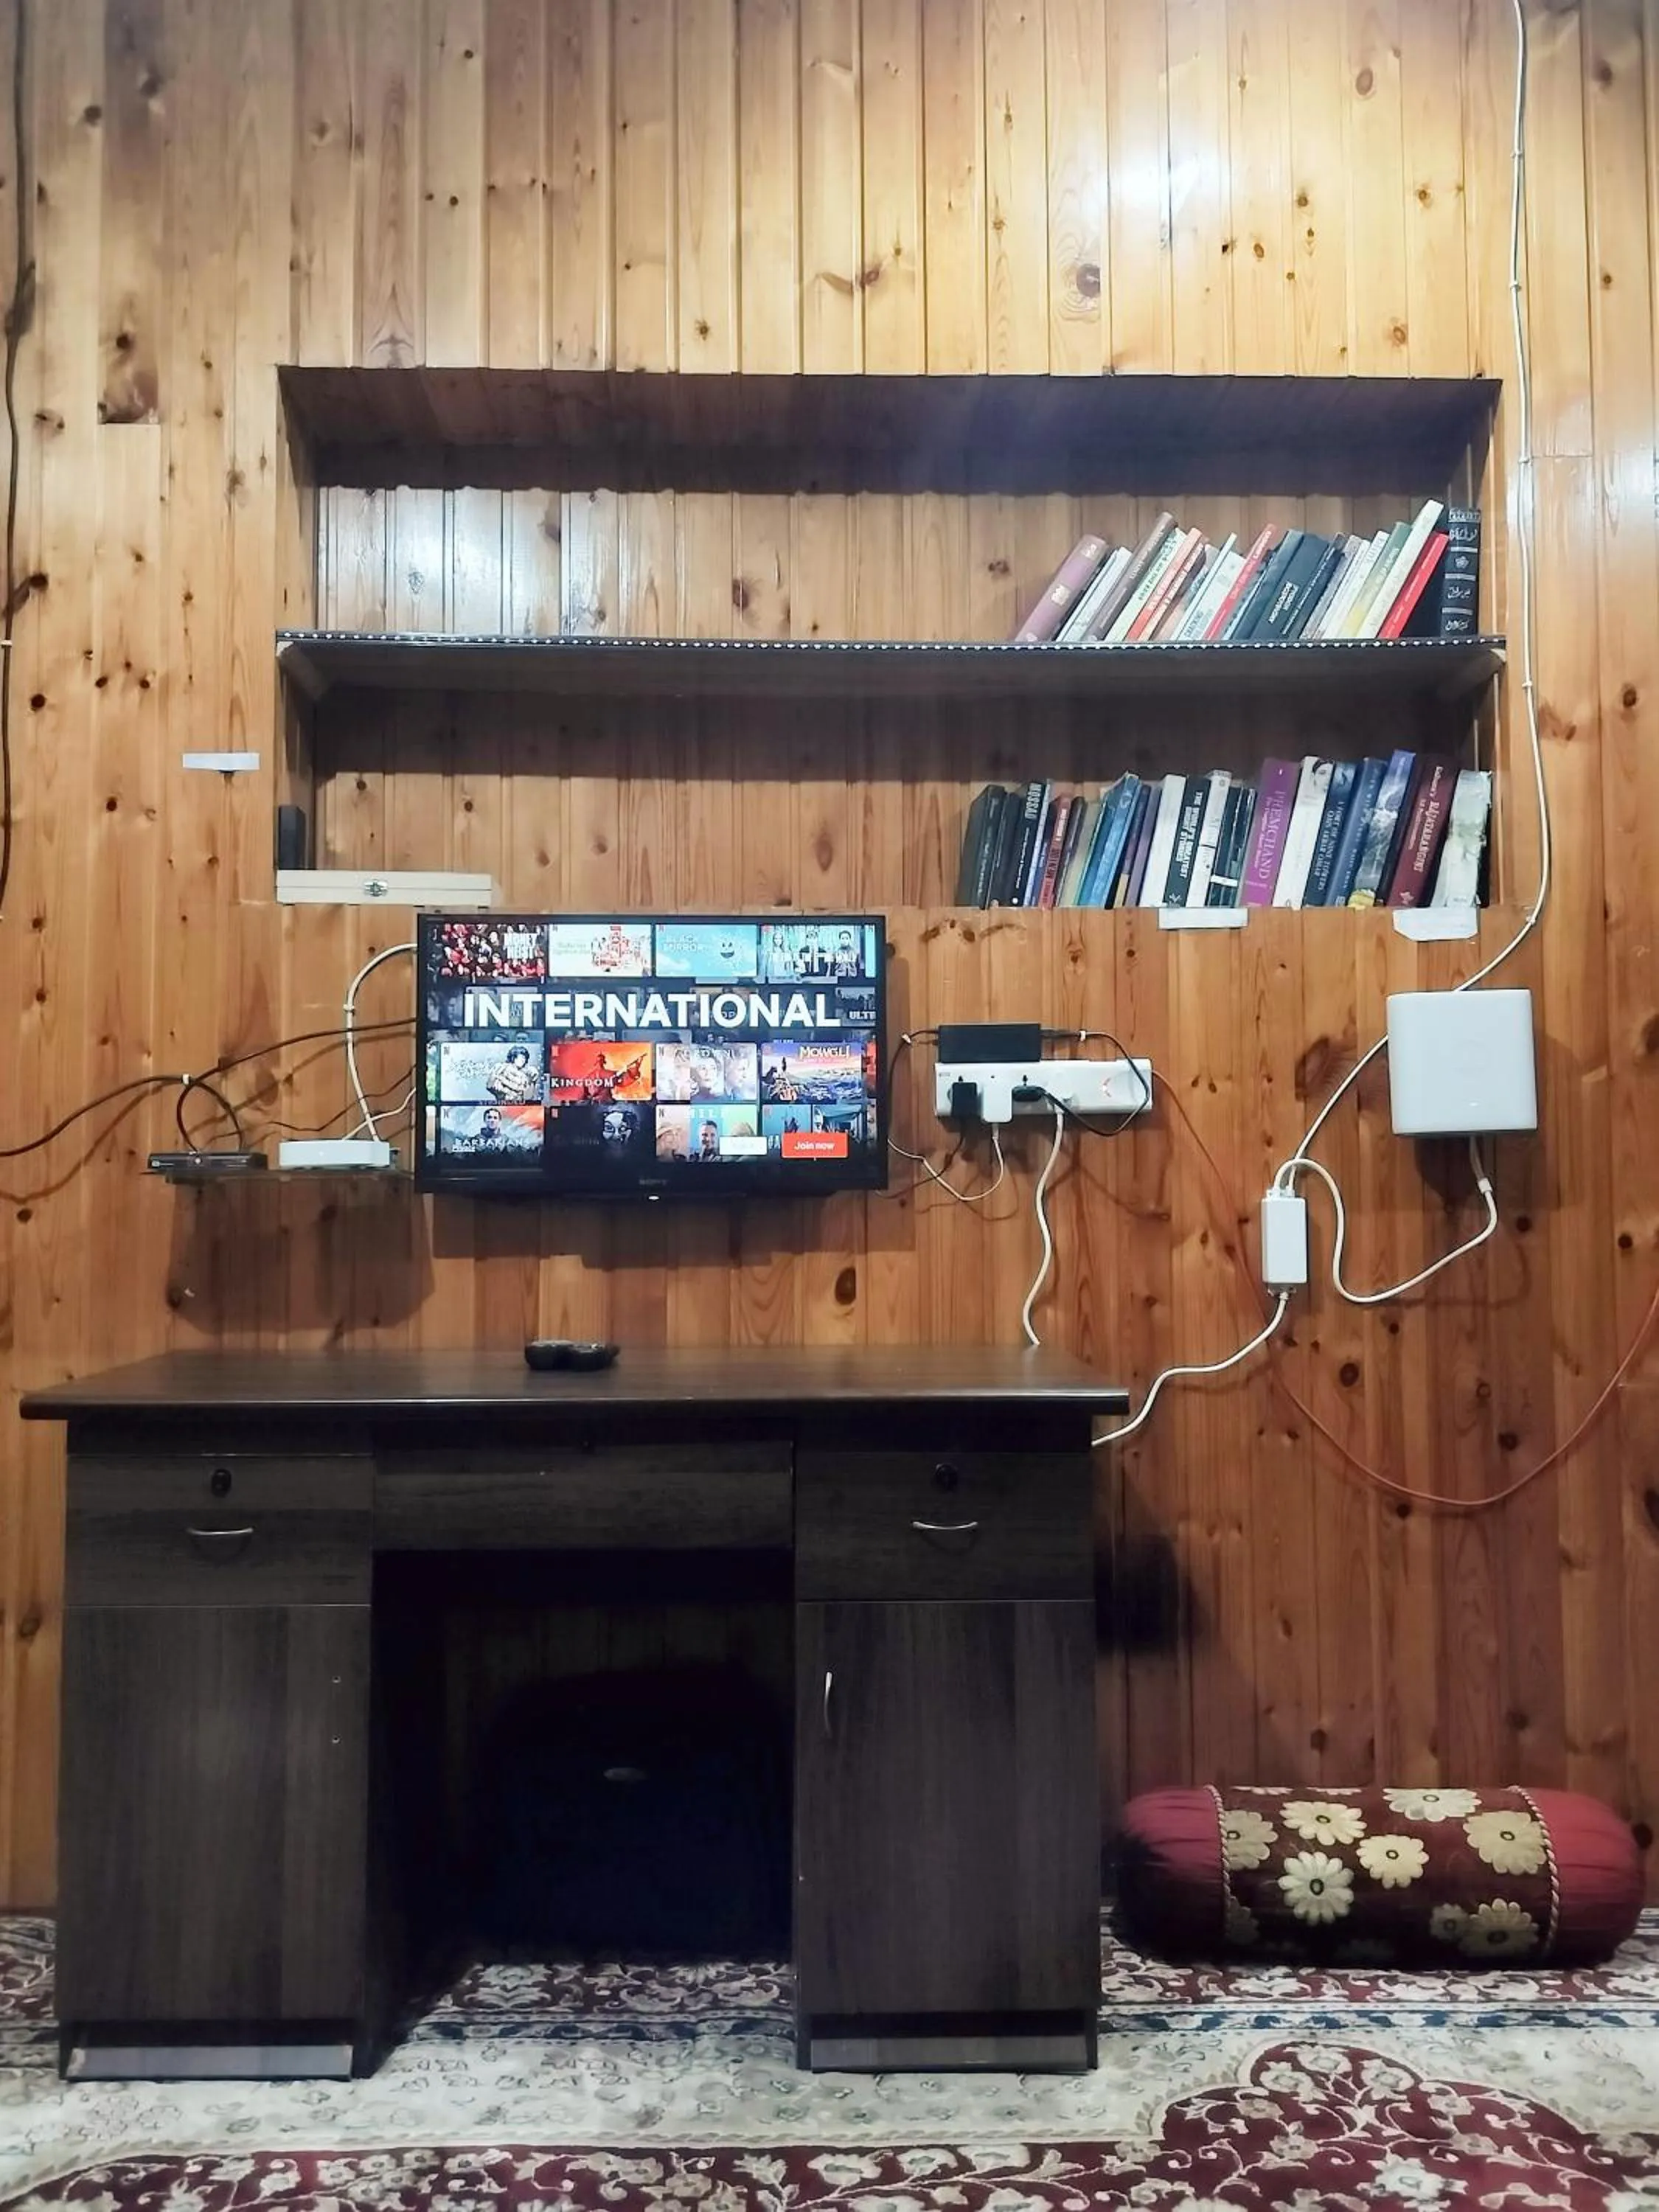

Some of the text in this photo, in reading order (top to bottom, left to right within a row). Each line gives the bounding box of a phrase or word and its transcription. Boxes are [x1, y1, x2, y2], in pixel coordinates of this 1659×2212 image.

[1025, 782, 1042, 820] MOSSAD
[1259, 790, 1286, 880] PREMCHAND
[464, 992, 841, 1027] INTERNATIONAL
[799, 1046, 850, 1060] MOWGLI
[551, 1075, 616, 1088] KINGDOM
[794, 1141, 835, 1151] Join now
